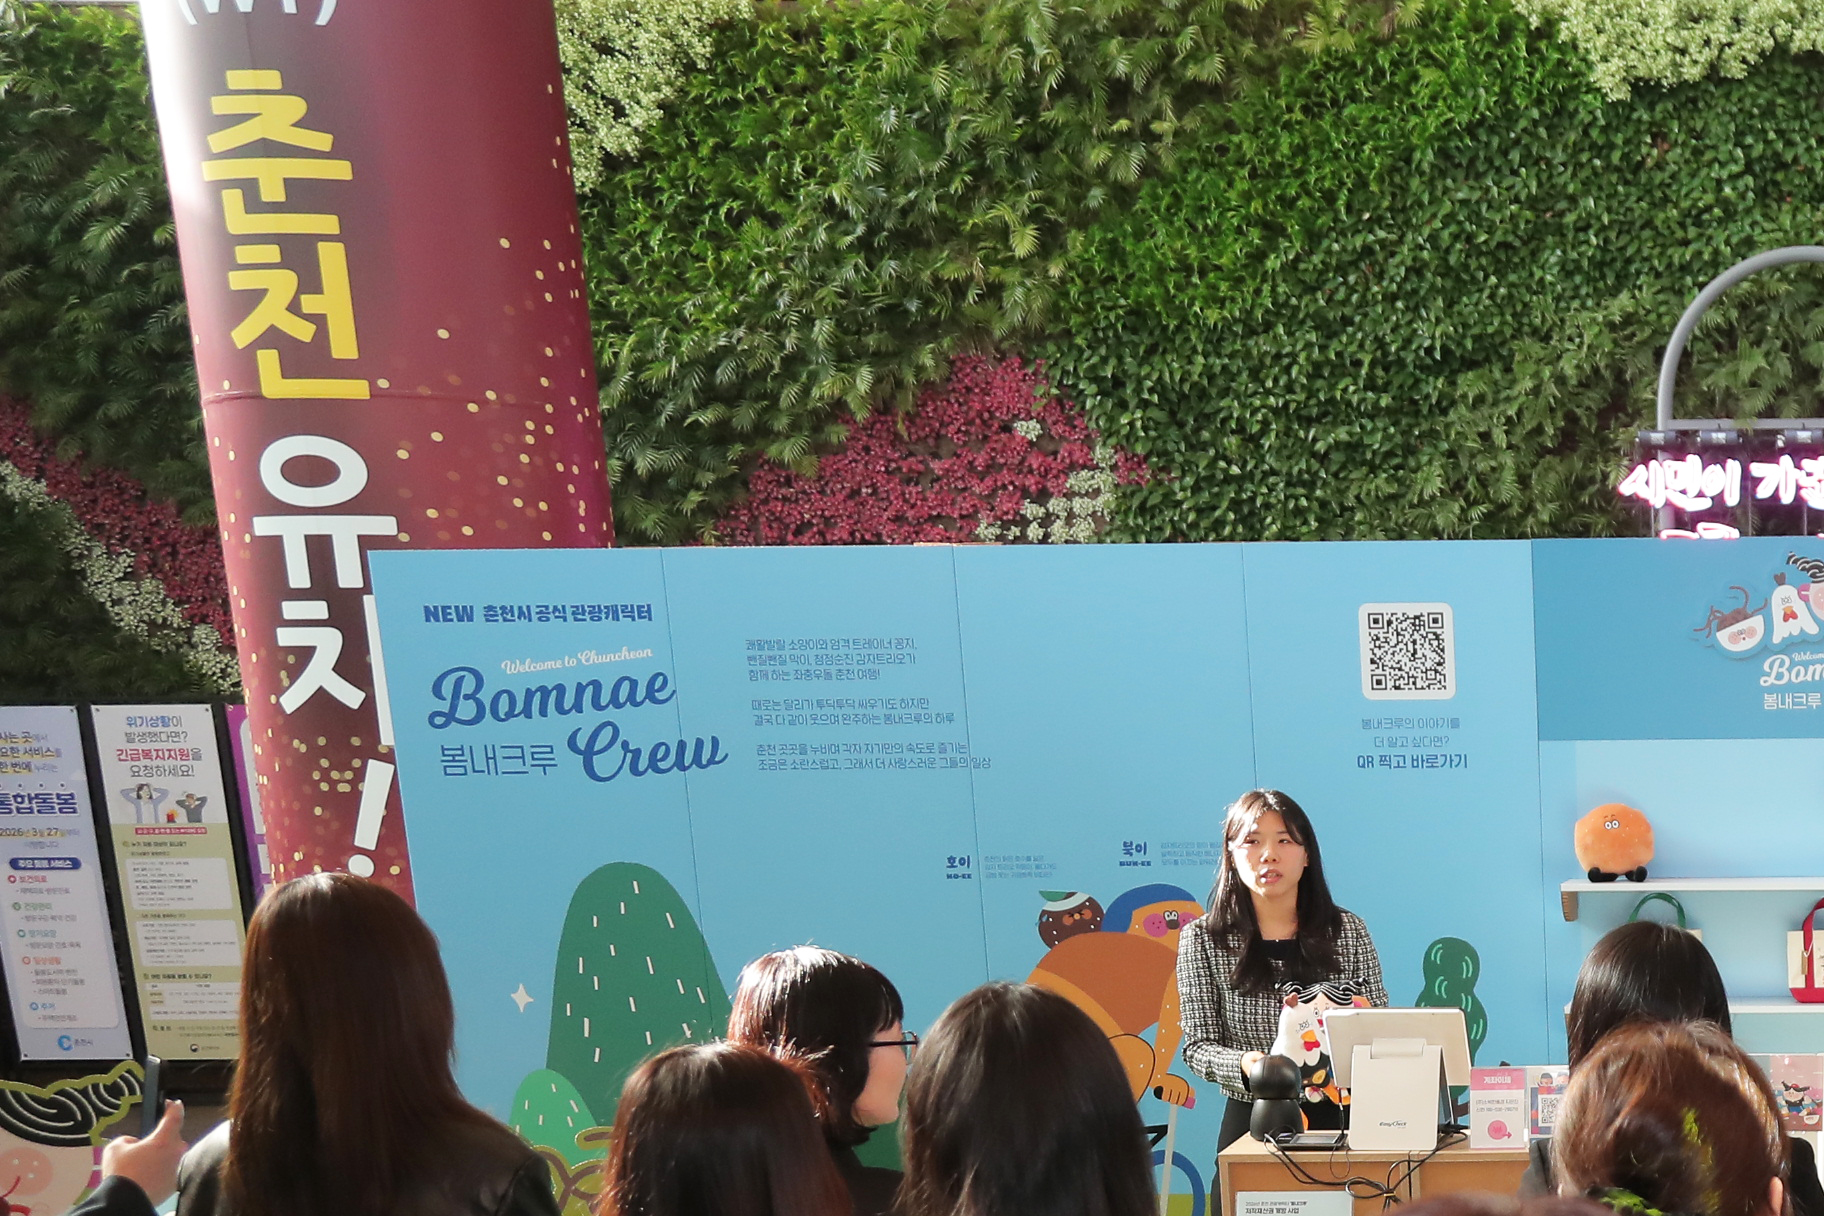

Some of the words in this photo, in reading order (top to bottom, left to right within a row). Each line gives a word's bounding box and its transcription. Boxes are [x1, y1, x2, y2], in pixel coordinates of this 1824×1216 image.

[202, 70, 370, 400] 춘천
[423, 604, 475, 623] NEW
[483, 604, 533, 623] 춘천시
[535, 604, 568, 623] 공식
[570, 603, 653, 622] 관광캐릭터
[853, 638, 892, 650] 트레이너
[253, 434, 398, 878] 유치!
[501, 656, 563, 675] Welcome
[564, 655, 577, 668] to
[577, 646, 653, 666] Chuncheon
[856, 653, 916, 666] 감자트리오가
[748, 669, 769, 682] 함께
[771, 668, 791, 681] 하는
[793, 668, 833, 681] 좌충우돌
[836, 668, 855, 681] 춘천
[857, 668, 880, 681] 여행!
[428, 666, 676, 730] Bomnae
[751, 699, 782, 711] 때로는
[816, 698, 855, 710] 투닥투닥
[858, 698, 898, 710] 싸우기도
[900, 697, 929, 710] 하지만
[1763, 693, 1822, 710] 봄내크루
[126, 715, 183, 728] 위기상황이
[753, 714, 773, 726] 결국
[776, 714, 785, 725] 다
[787, 713, 808, 726] 같이
[810, 713, 839, 726] 웃으며
[842, 713, 881, 725] 완주하는
[884, 712, 933, 725] 봄내크루의
[935, 712, 955, 724] 하루
[1361, 718, 1414, 730] 봄내크루의
[1417, 717, 1461, 729] 이야기를
[124, 730, 188, 744] 발생했다면?
[1374, 736, 1384, 748] 더
[1388, 736, 1409, 748] 알고
[1412, 735, 1450, 748] 싶다면?
[116, 748, 203, 762] 긴급복지지원을
[567, 720, 729, 783] Crew
[757, 744, 776, 756] 춘천
[779, 743, 808, 756] 곳곳을
[810, 743, 840, 755] 누비며
[842, 743, 862, 755] 각자
[864, 742, 904, 755] 자기만의
[906, 742, 936, 754] 속도로
[938, 741, 967, 754] 즐기는
[11, 761, 32, 774] 번에
[440, 744, 558, 777] 봄내크루
[759, 759, 787, 771] 조금은
[790, 758, 842, 771] 소란스럽고,
[844, 758, 873, 770] 그래서
[875, 757, 886, 769] 더
[888, 757, 937, 770] 사랑스러운
[940, 757, 969, 769] 그들의
[971, 757, 992, 769] 일상
[1357, 755, 1375, 769] QR
[1379, 754, 1406, 769] 찍고
[1411, 754, 1468, 769] 바로가기
[129, 764, 196, 778] 요청하세요!
[0, 792, 79, 814] 통합돌봄
[1122, 840, 1147, 857] 북이
[946, 855, 971, 869] 호이
